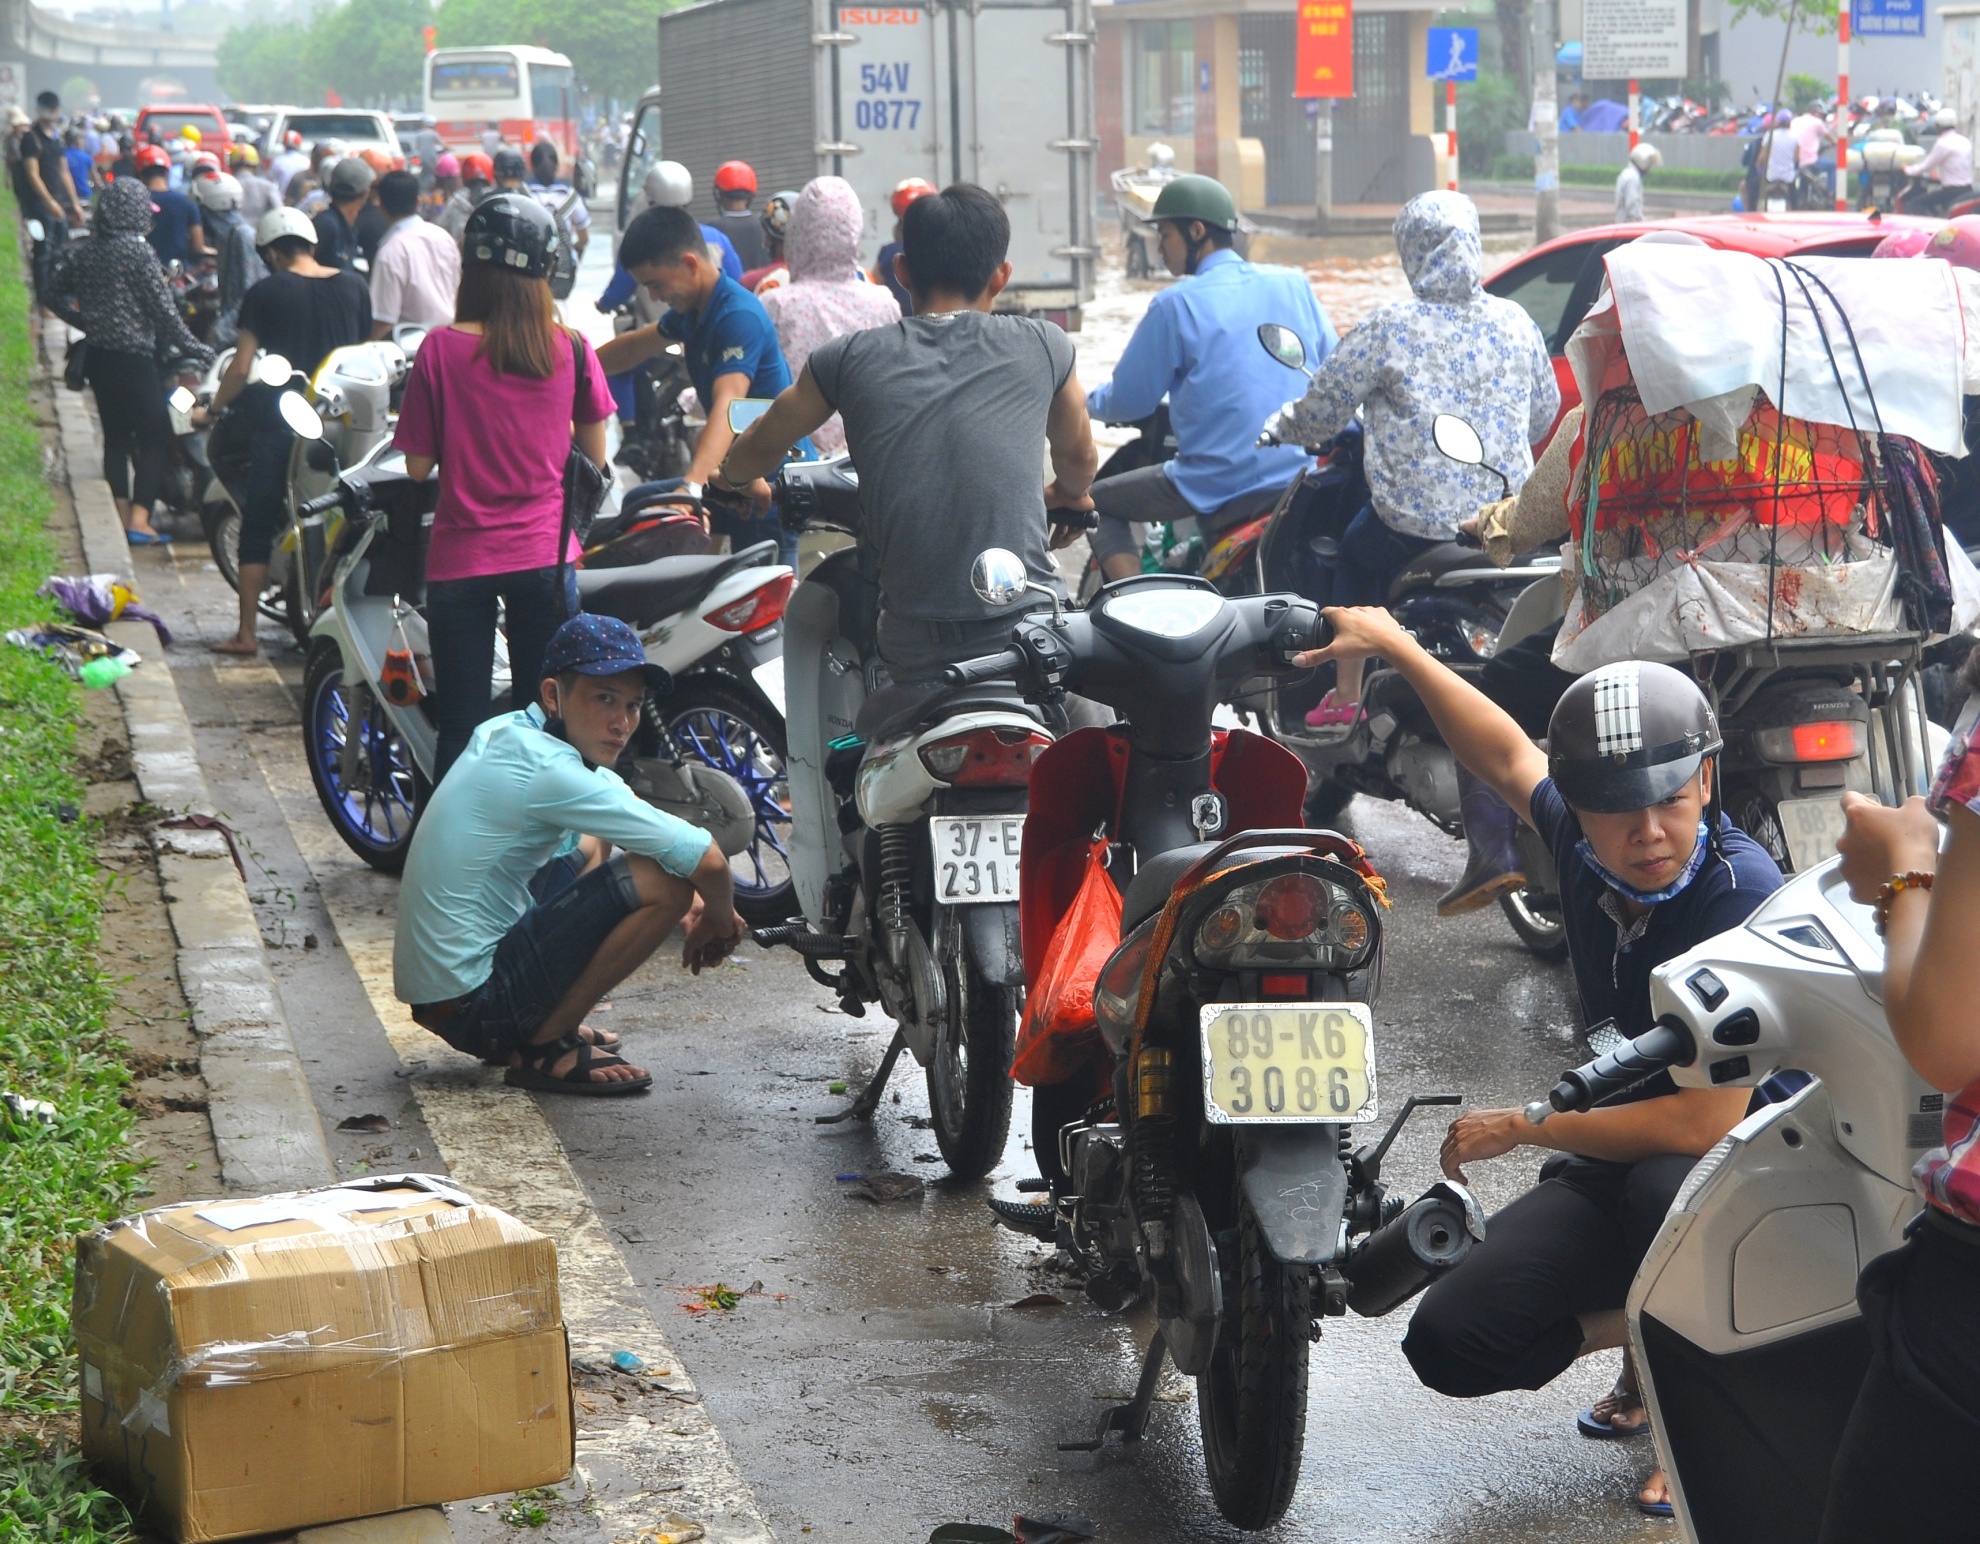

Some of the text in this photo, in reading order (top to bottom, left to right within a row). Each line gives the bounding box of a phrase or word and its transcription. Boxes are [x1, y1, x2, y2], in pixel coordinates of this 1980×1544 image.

[841, 9, 919, 25] ISUZU
[861, 63, 910, 94] 54V
[855, 100, 921, 130] 0877
[1813, 702, 1850, 710] HONDA
[827, 714, 854, 730] HONDA
[949, 821, 1020, 857] 37-E
[943, 860, 1020, 897] 231.
[1227, 1012, 1347, 1060] 89-K6
[1230, 1066, 1351, 1113] 3086
